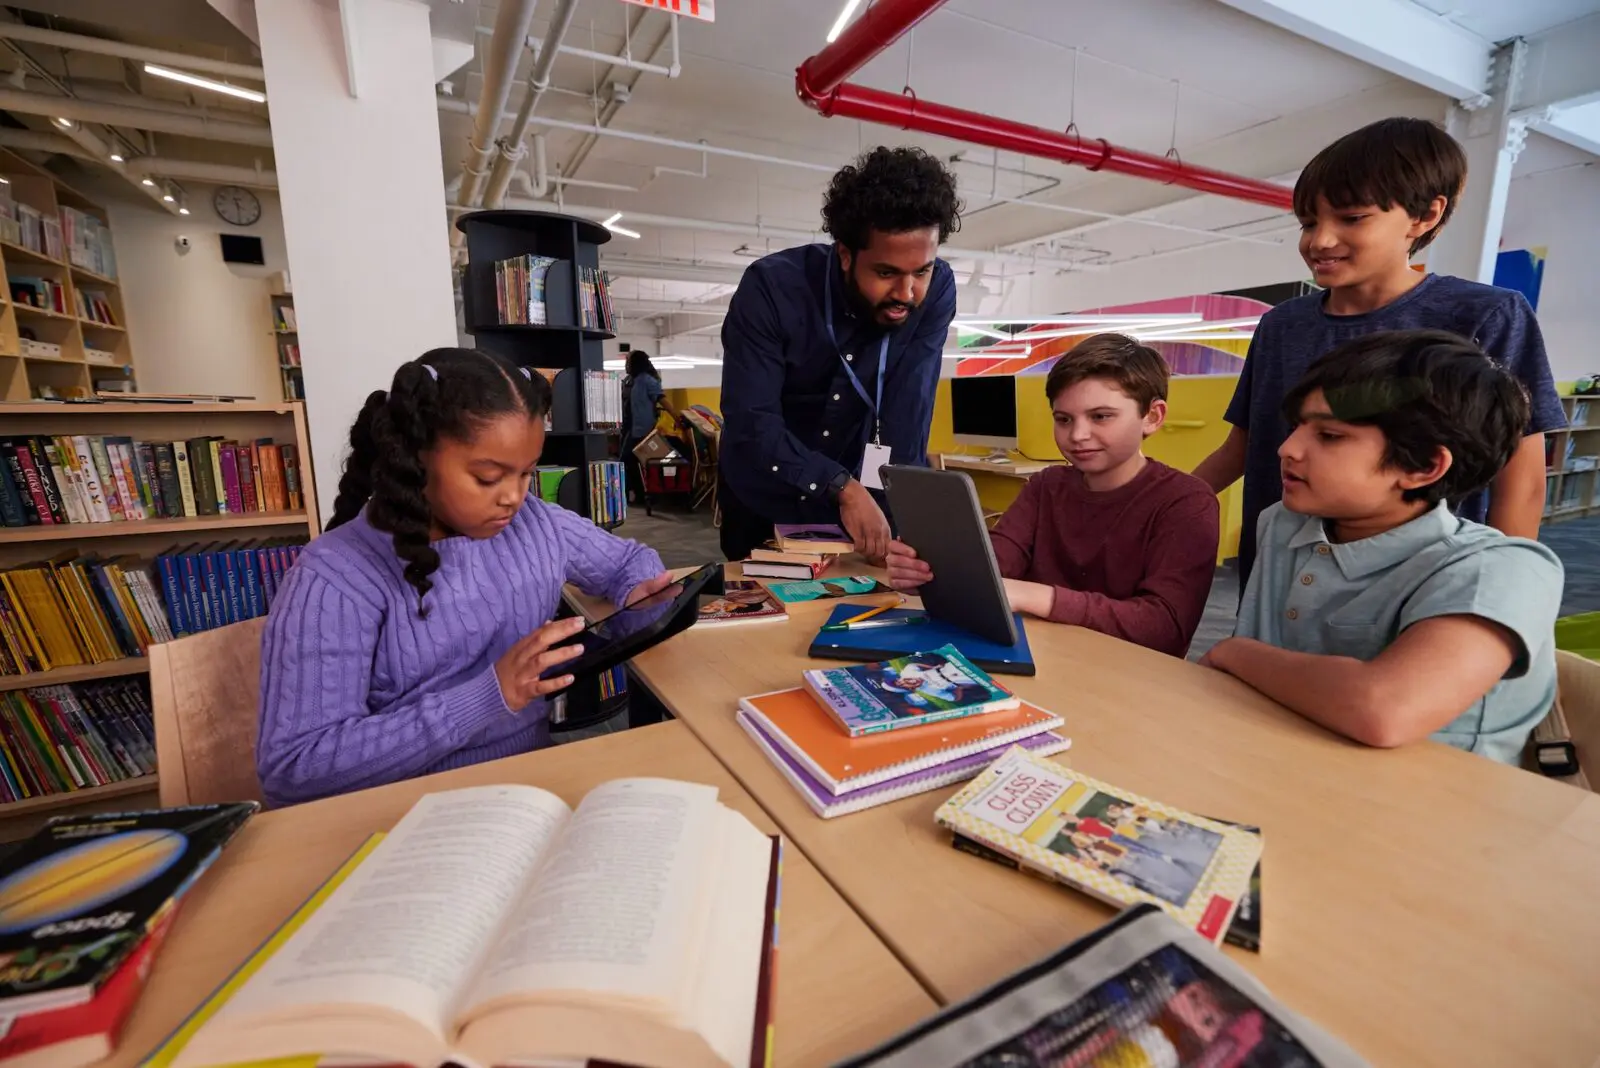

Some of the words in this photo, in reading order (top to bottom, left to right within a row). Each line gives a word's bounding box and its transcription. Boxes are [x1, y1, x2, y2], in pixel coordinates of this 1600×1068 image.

[34, 456, 58, 512] LINKED
[168, 576, 180, 602] Children's
[189, 575, 199, 601] Children's
[208, 573, 217, 599] Children's
[228, 570, 237, 596] Children's
[247, 569, 256, 594] Children's
[173, 603, 183, 630] Dictionary
[193, 602, 202, 629] Dictionary
[987, 773, 1037, 812] CLASS
[1006, 780, 1063, 824] CLOWN
